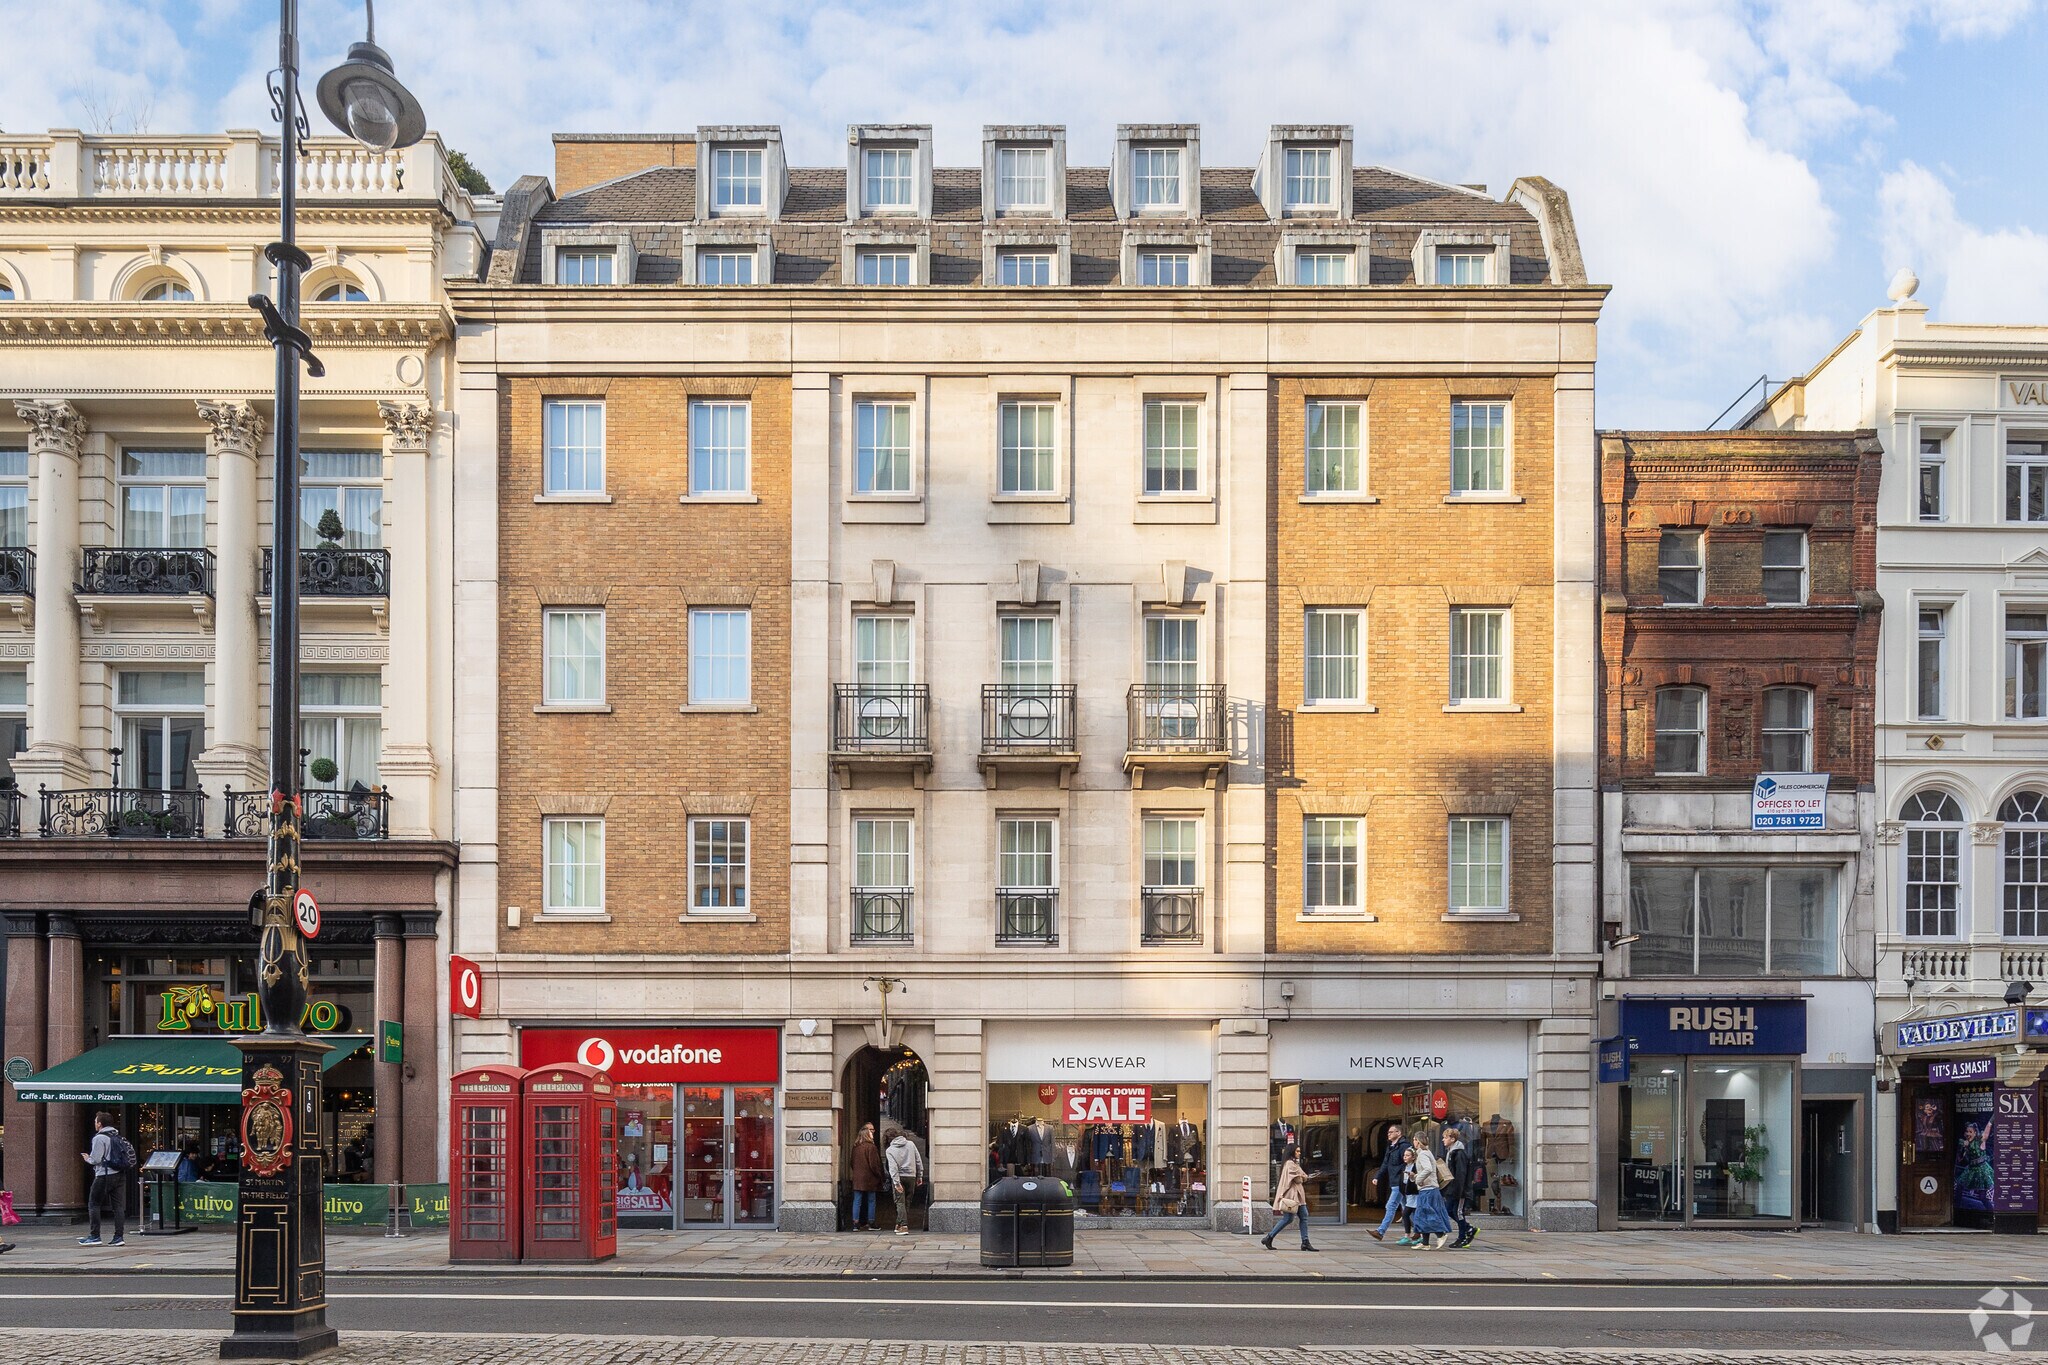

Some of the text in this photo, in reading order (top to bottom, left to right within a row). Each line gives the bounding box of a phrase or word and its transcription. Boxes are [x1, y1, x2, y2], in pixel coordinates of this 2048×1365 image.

[299, 902, 316, 925] 20
[1670, 1007, 1754, 1030] RUSH
[1900, 1015, 2016, 1044] VAUDEVILLE
[1710, 1032, 1754, 1045] HAIR
[619, 1044, 722, 1064] vodafone
[1052, 1057, 1146, 1068] MENSWEAR
[1350, 1057, 1444, 1068] MENSWEAR
[1952, 1064, 1958, 1075] A
[1041, 1086, 1054, 1096] sale
[1069, 1097, 1145, 1121] SALE
[1434, 1098, 1446, 1108] sale
[1998, 1094, 2034, 1114] SIX
[798, 1132, 818, 1141] 408
[1924, 1180, 1934, 1189] A
[631, 1196, 661, 1209] SALE
